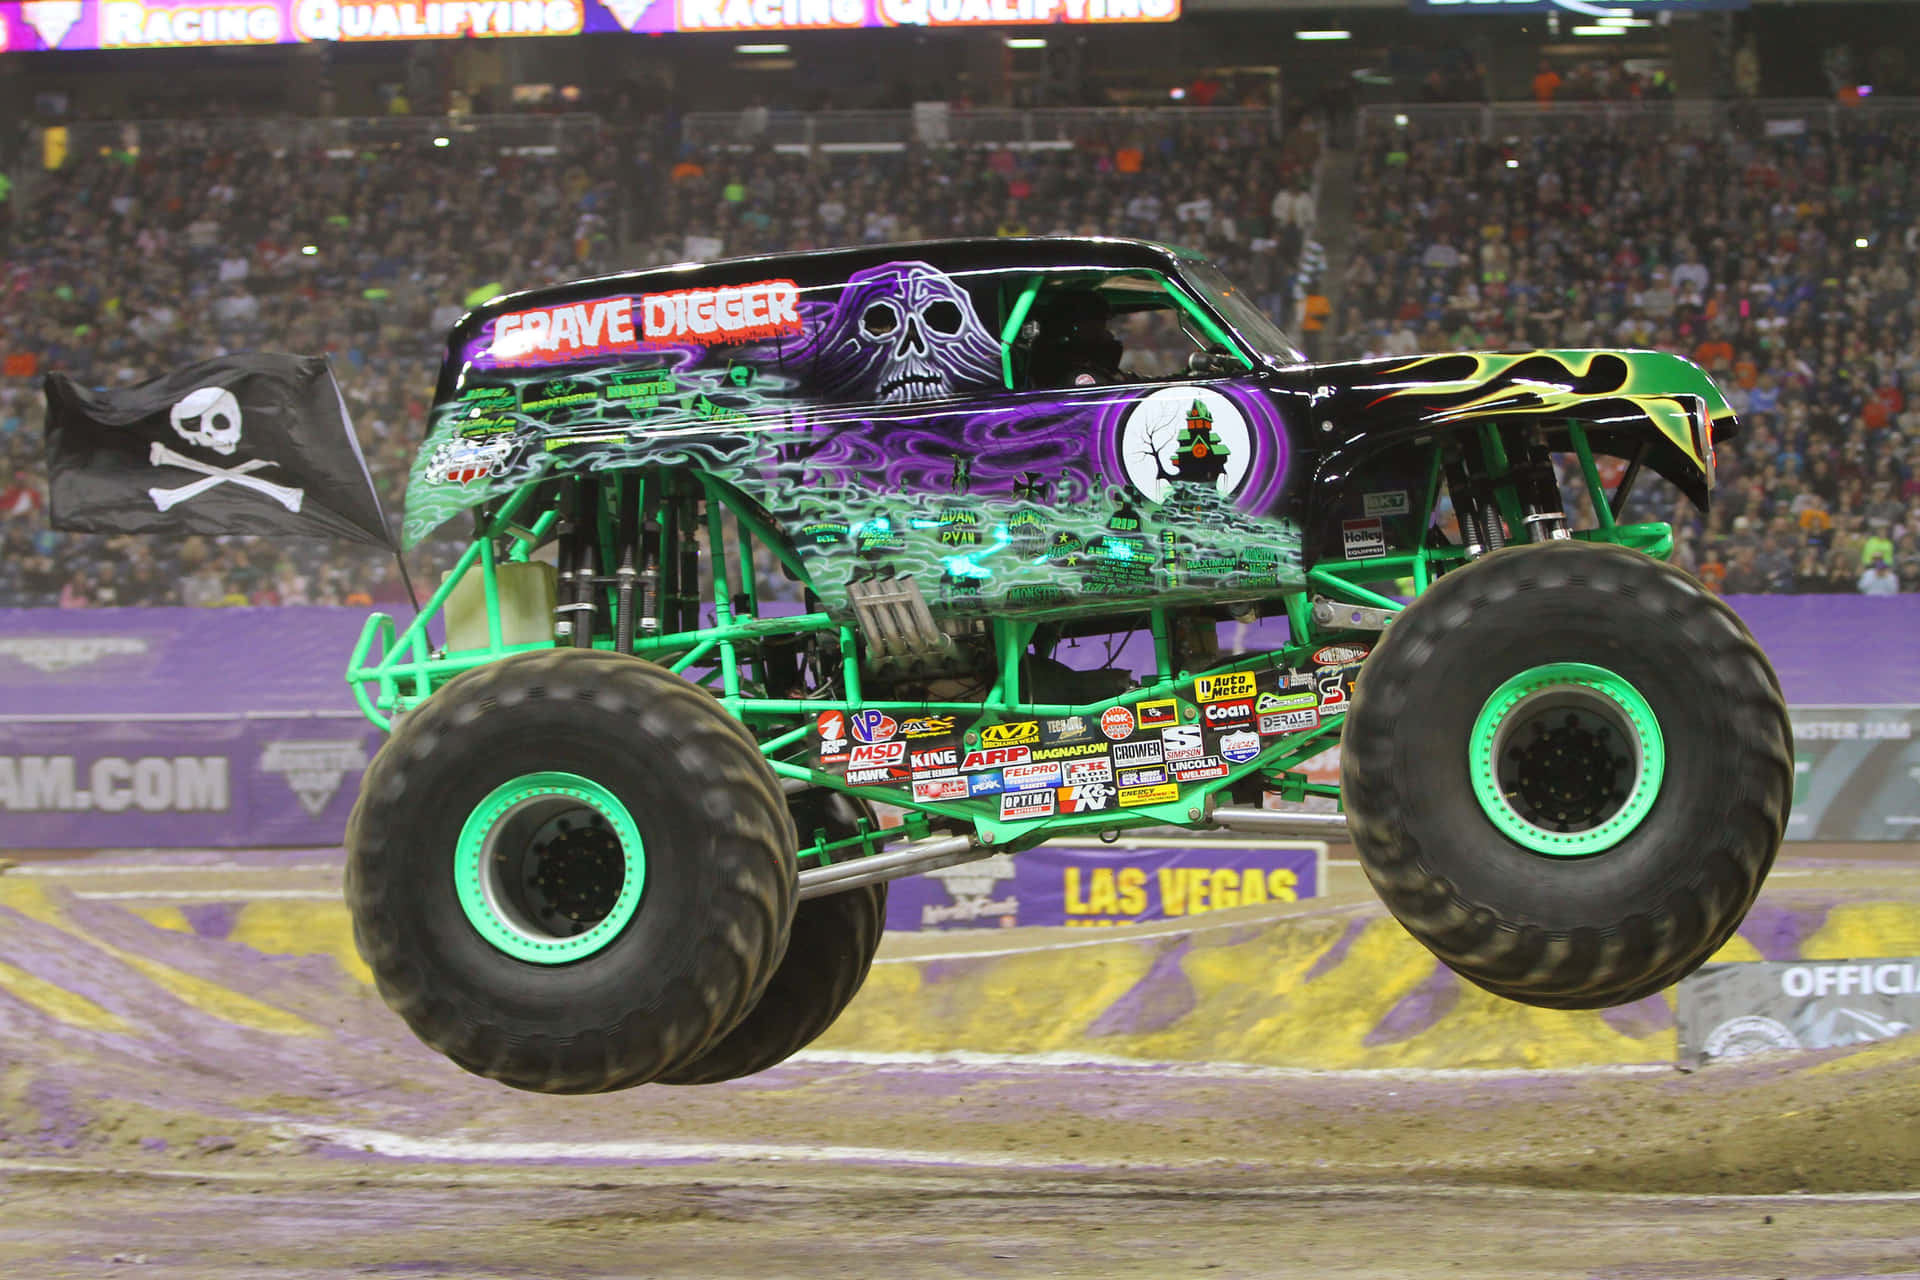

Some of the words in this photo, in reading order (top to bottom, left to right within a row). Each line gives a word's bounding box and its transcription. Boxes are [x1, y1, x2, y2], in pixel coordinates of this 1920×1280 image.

[103, 2, 278, 44] RACING
[301, 0, 579, 41] QUALIFYING
[493, 298, 633, 356] GRAVE
[643, 282, 799, 338] DIGGER
[1110, 517, 1138, 530] RIP
[1345, 531, 1382, 544] Holley
[1213, 675, 1246, 688] Auto
[1212, 684, 1253, 699] Meter
[1106, 713, 1128, 724] NGK
[1205, 704, 1250, 720] Coan
[851, 709, 882, 743] VP
[899, 720, 931, 733] PAC
[1862, 722, 1912, 739] JAM
[853, 743, 903, 762] MSD
[911, 750, 957, 768] KING
[963, 747, 1029, 768] ARP
[1032, 743, 1108, 761] MAGNAFLOW
[1115, 742, 1160, 760] CROWER
[1166, 748, 1201, 760] SIMPSON
[1005, 764, 1059, 778] FEL-PRO
[1170, 758, 1217, 772] LINCOLN
[1181, 767, 1223, 779] WELDERS
[846, 768, 890, 784] HAWK
[1005, 791, 1052, 809] OPTIMA
[1064, 867, 1147, 915] LAS
[1158, 867, 1298, 916] VEGAS
